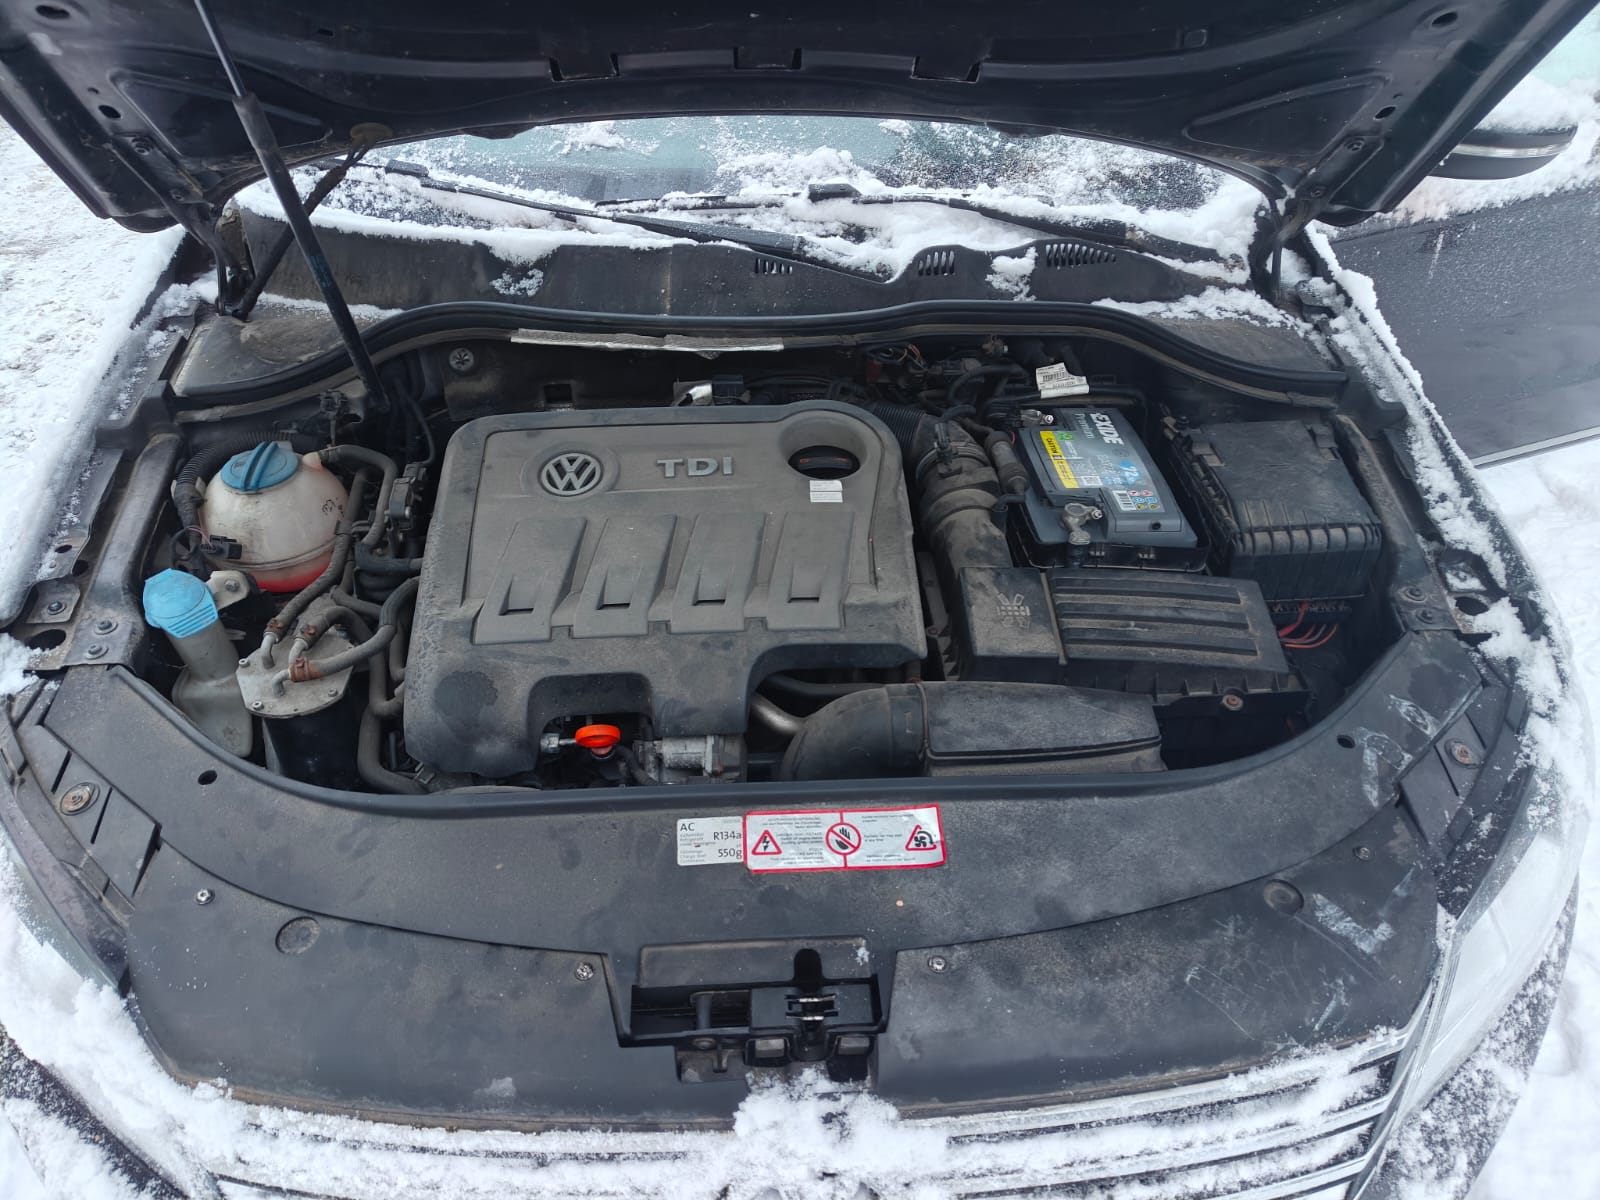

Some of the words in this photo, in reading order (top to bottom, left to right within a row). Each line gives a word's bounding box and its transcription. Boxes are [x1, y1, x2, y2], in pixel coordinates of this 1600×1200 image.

[1090, 412, 1125, 446] EXIDE
[656, 456, 734, 478] TDI
[680, 823, 695, 832] AC
[713, 831, 742, 841] R134a
[718, 848, 742, 860] 550g
